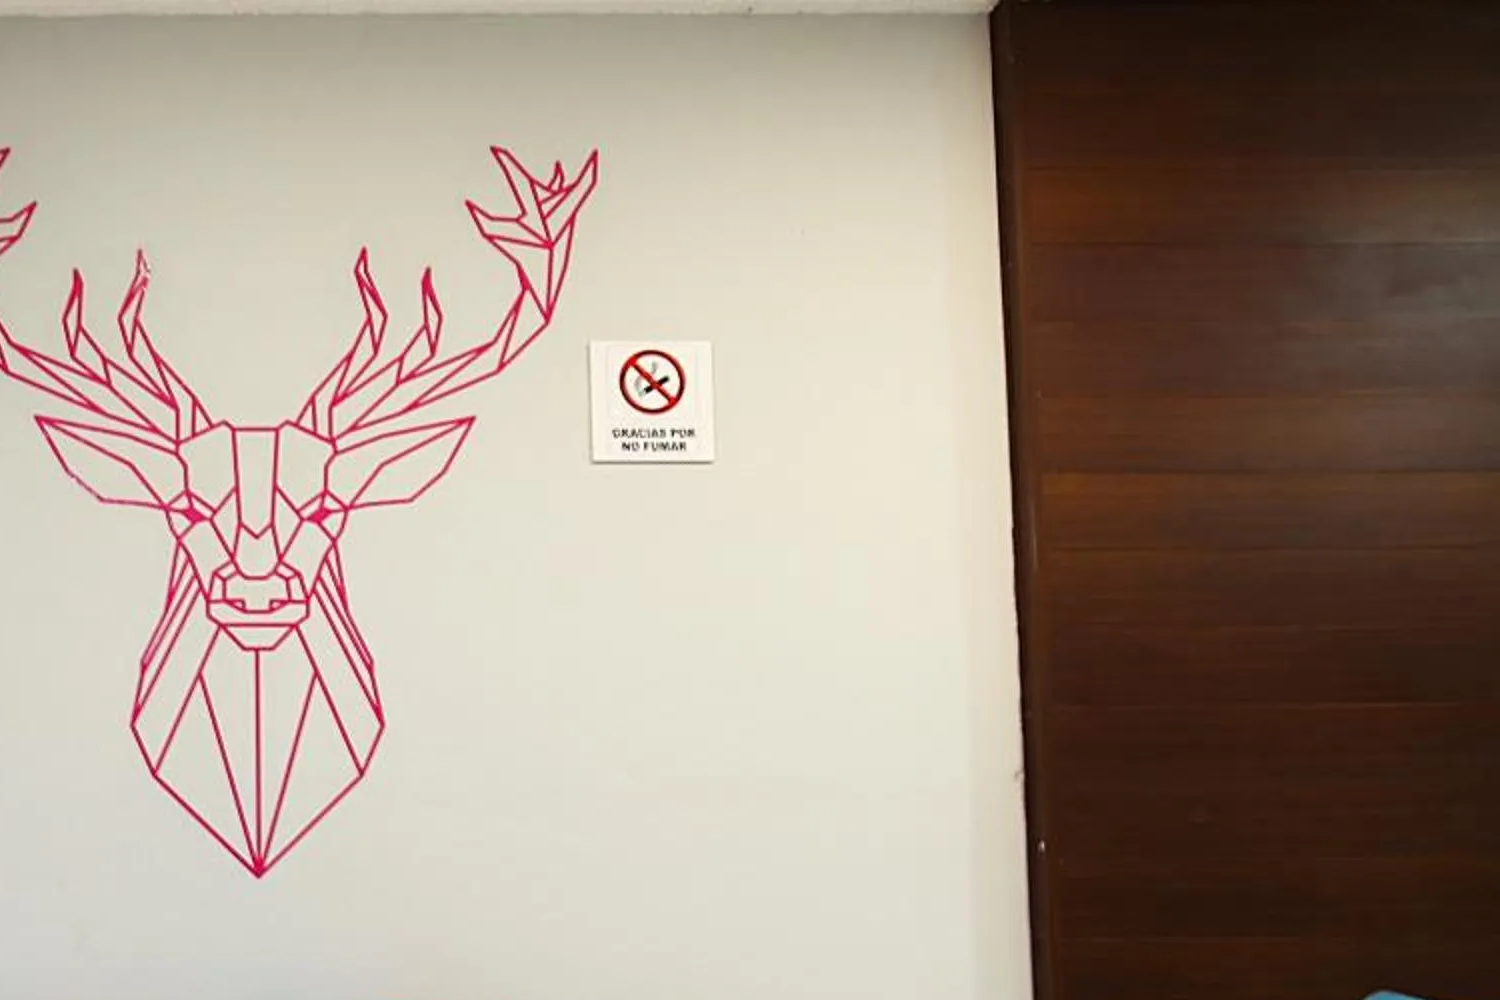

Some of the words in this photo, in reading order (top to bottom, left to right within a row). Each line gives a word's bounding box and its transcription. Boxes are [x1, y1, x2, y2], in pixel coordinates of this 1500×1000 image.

[611, 427, 666, 439] GRACIAS
[670, 427, 696, 438] POR
[621, 441, 640, 451] NO
[643, 441, 687, 451] FUMAR
